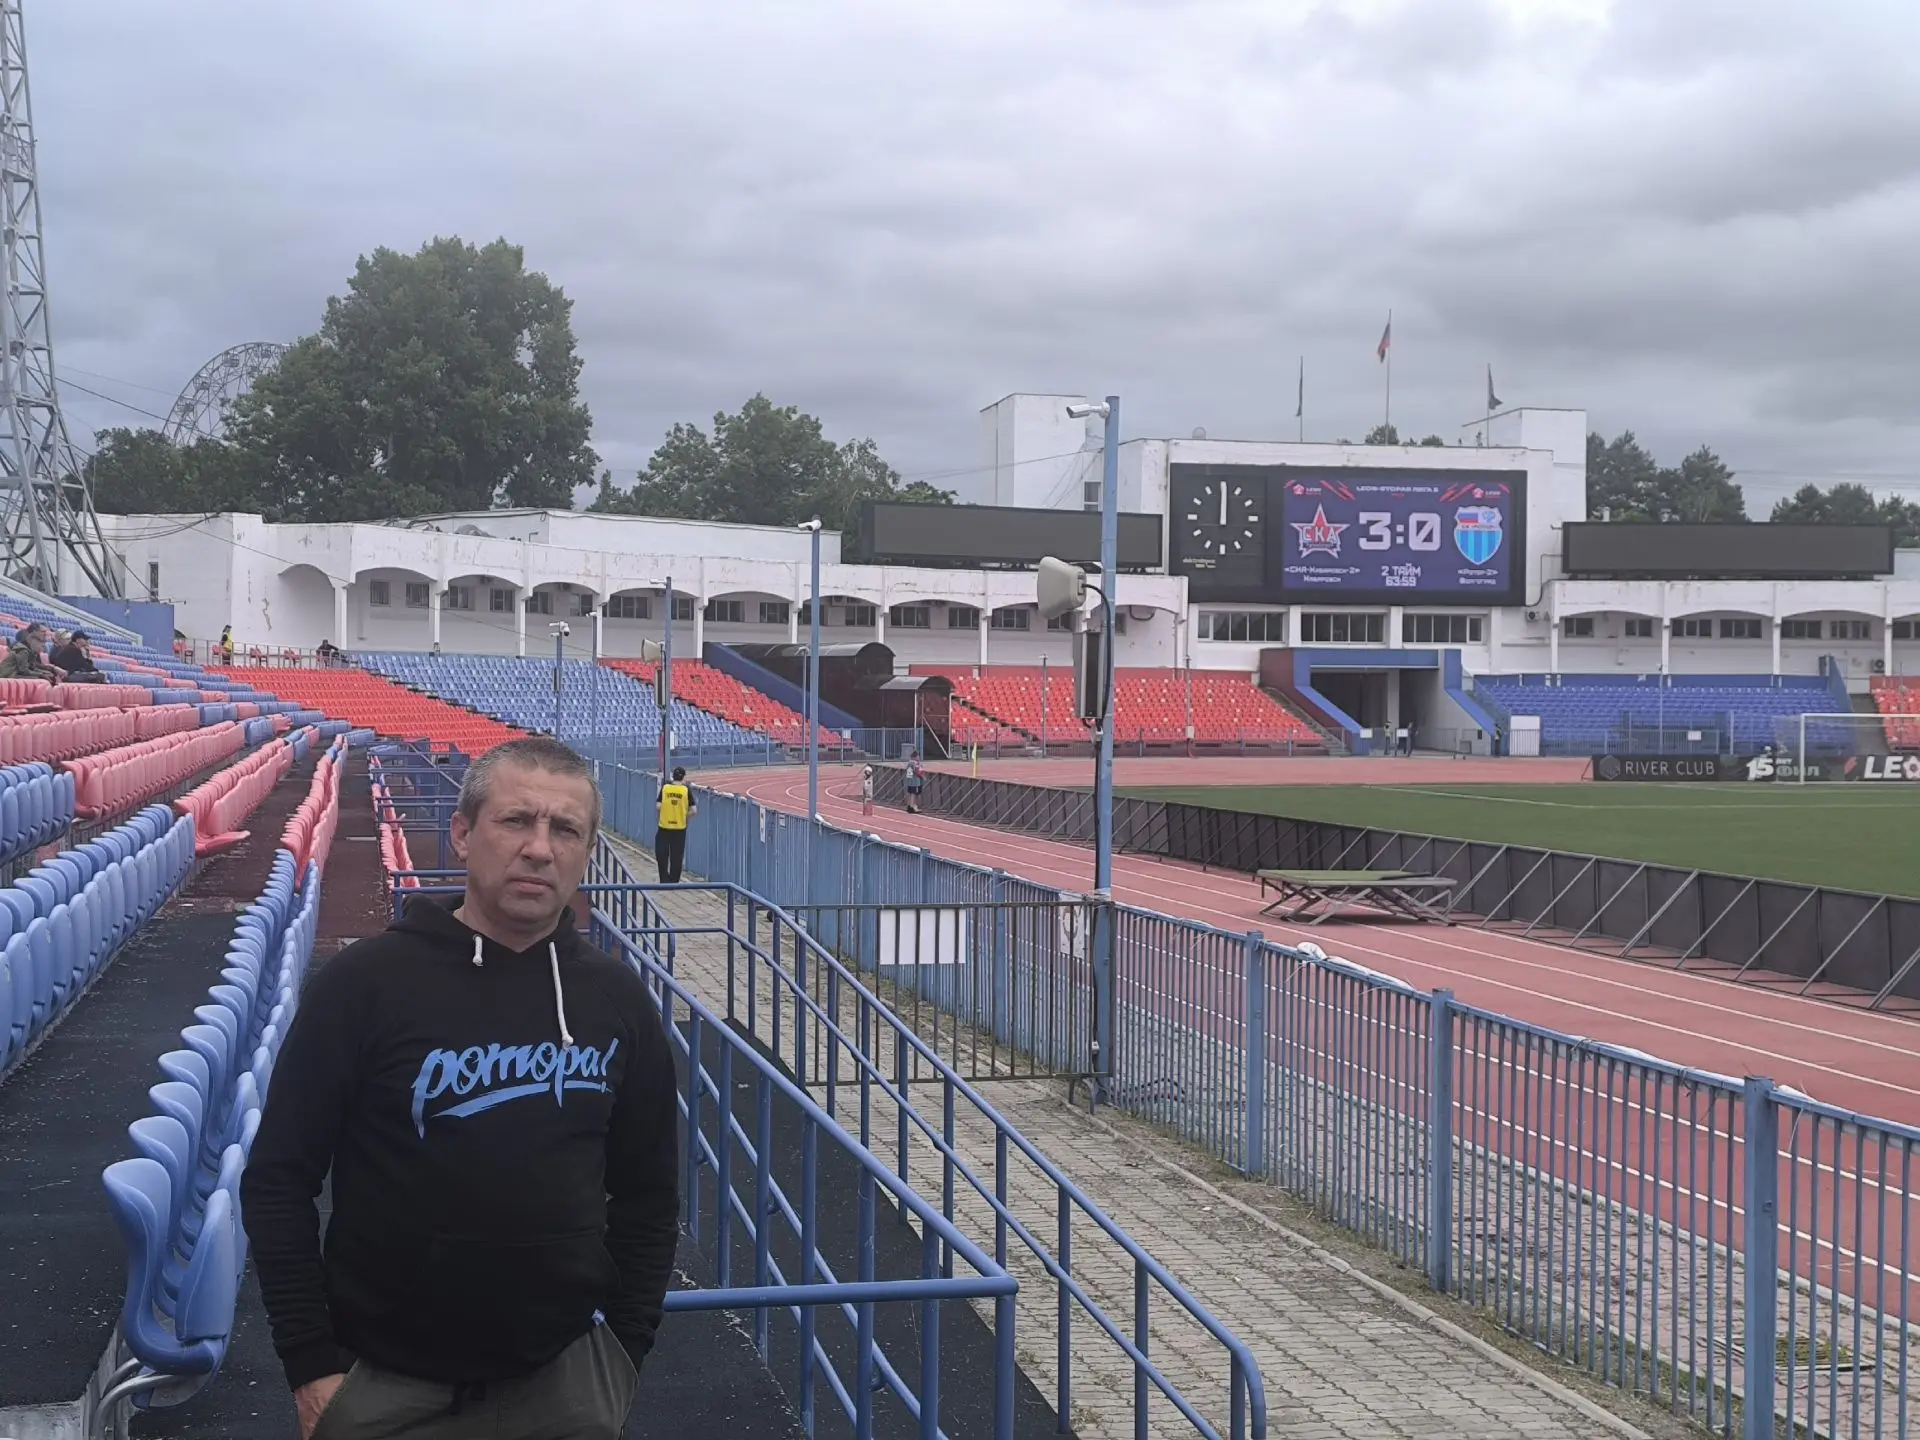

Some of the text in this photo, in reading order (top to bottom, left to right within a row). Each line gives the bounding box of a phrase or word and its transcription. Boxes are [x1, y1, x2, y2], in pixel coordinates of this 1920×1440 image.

[1359, 511, 1441, 551] 3:0
[1381, 565, 1390, 577] 2
[1625, 760, 1715, 776] RIVER CLUB
